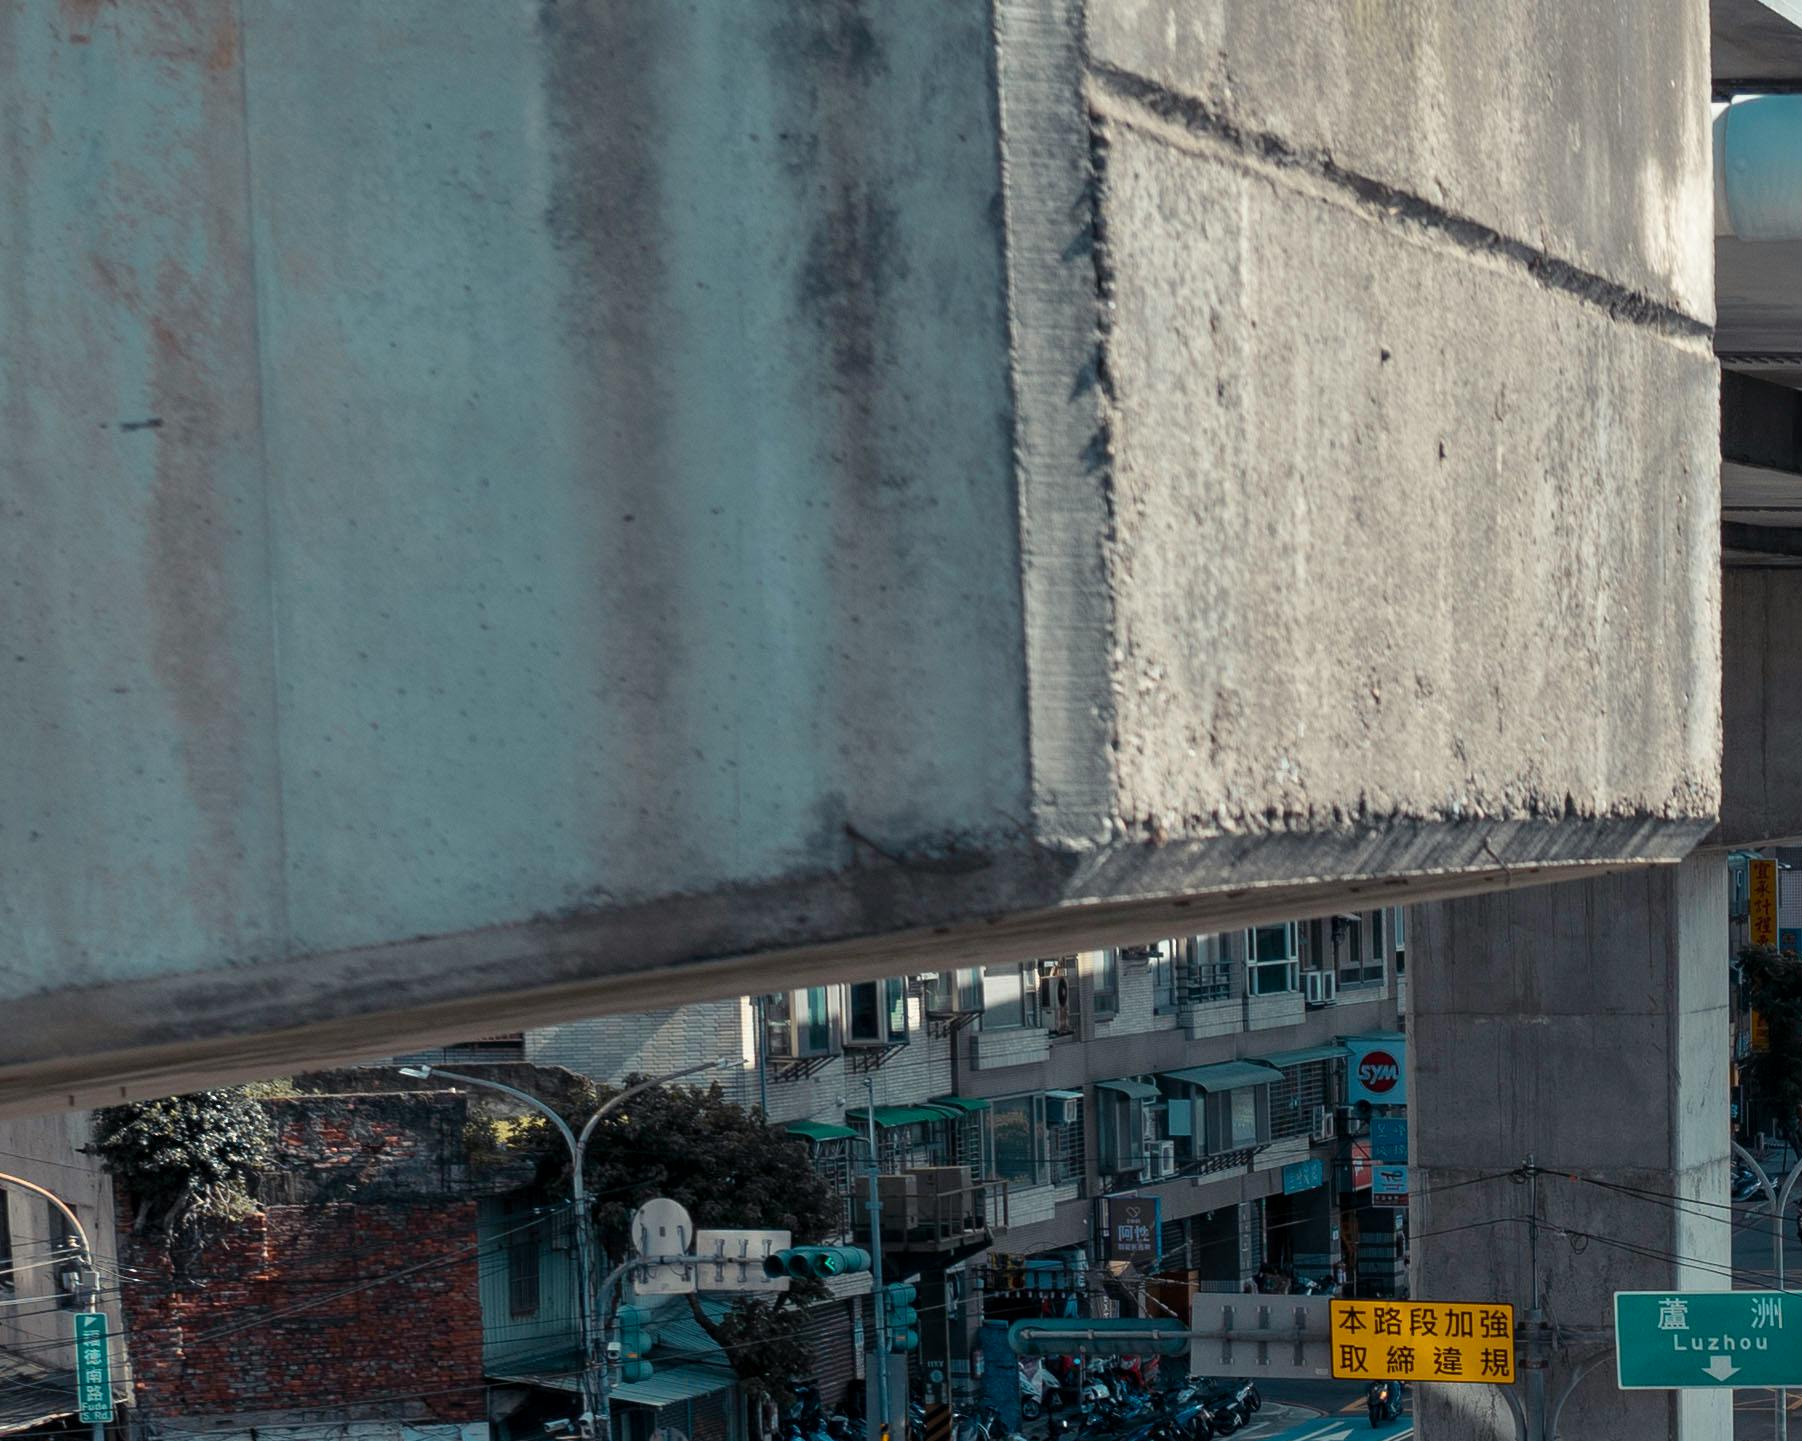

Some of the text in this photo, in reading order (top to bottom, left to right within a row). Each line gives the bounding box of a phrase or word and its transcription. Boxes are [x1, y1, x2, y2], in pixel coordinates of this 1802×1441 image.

[1359, 1064, 1398, 1085] SYM
[1338, 1306, 1510, 1339] 本路段加強
[1658, 1298, 1783, 1330] 蘆洲
[1674, 1334, 1768, 1351] Luzhou
[1340, 1344, 1510, 1377] 取締違規
